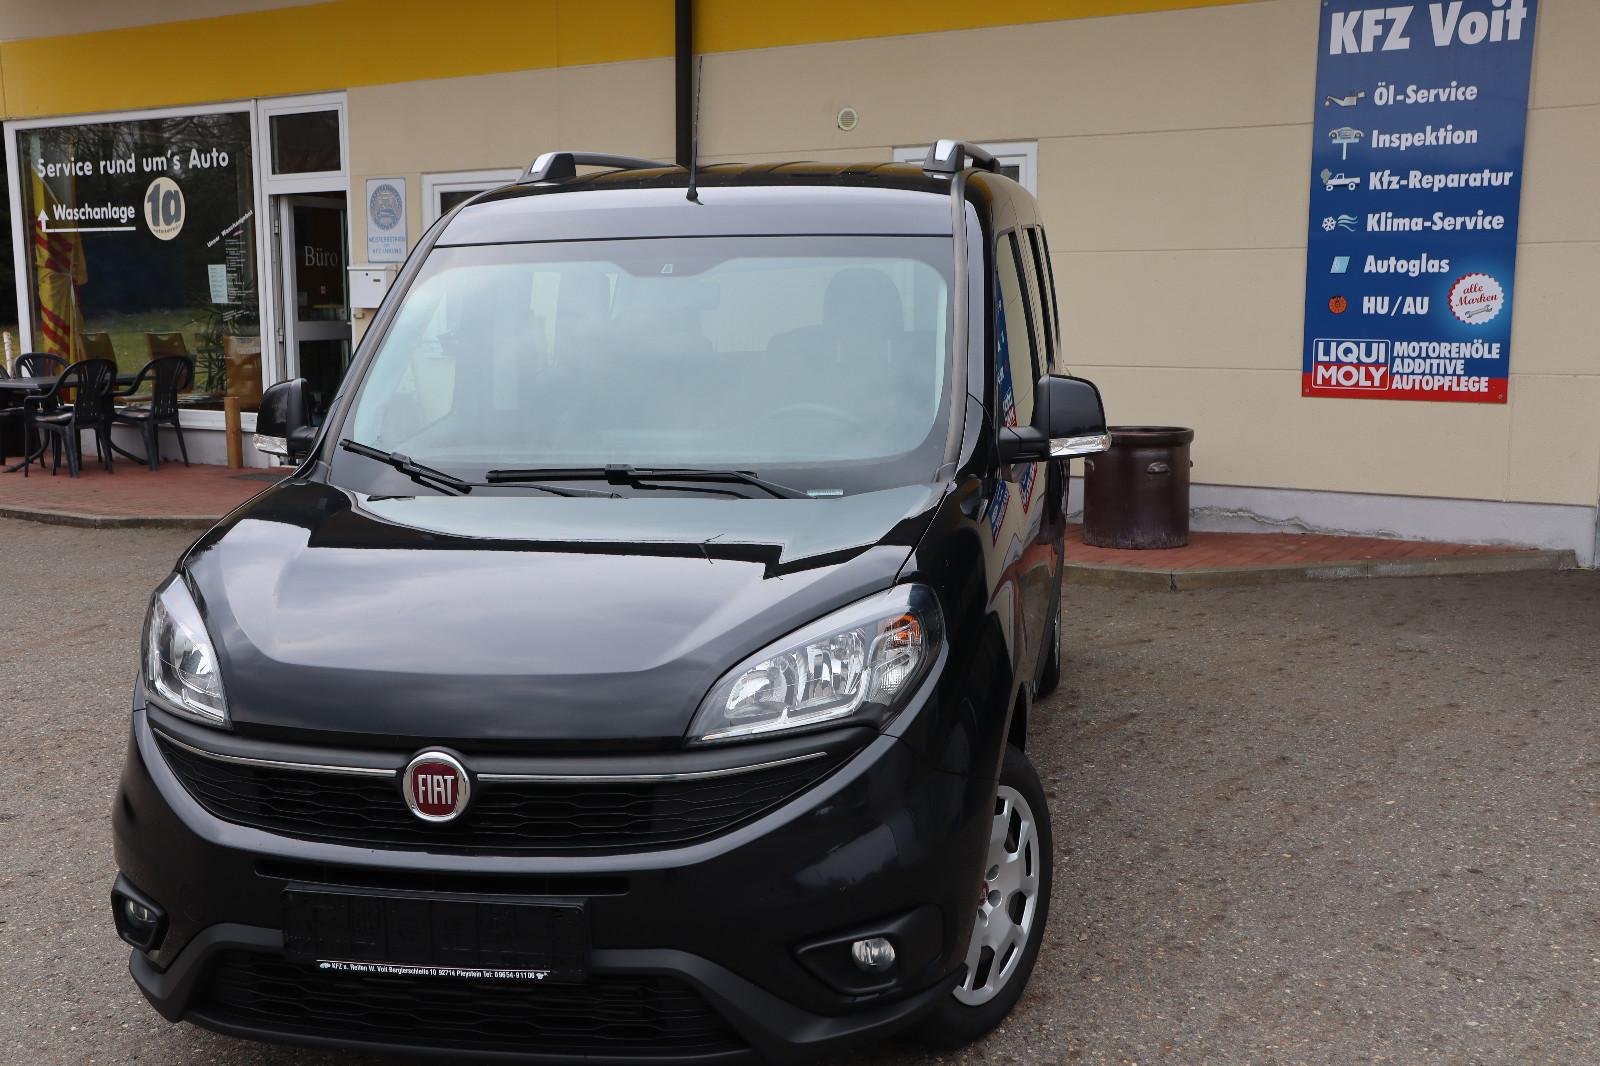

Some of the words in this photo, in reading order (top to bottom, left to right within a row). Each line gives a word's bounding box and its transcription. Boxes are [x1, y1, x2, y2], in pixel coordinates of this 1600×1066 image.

[1329, 6, 1414, 55] KFZ
[1429, 0, 1527, 47] Voit
[1374, 81, 1478, 106] Öl-Service
[1371, 124, 1478, 151] Inspektion
[37, 157, 93, 177] Service
[100, 153, 136, 174] rund
[143, 149, 180, 172] um's
[188, 147, 229, 169] Auto
[1368, 169, 1513, 192] Kfz-Reparatur
[53, 202, 136, 222] Waschanlage
[1366, 209, 1505, 232] Klima-Service
[304, 245, 338, 266] Büro
[1363, 253, 1450, 277] Autoglas
[1456, 293, 1499, 308] Marken
[1463, 284, 1484, 295] alle
[1317, 341, 1386, 364] LIQUI
[1393, 339, 1500, 359] MOTORENÖLE
[1316, 365, 1388, 387] MOLY
[1392, 359, 1465, 375] ADDITIVE
[1391, 375, 1489, 392] AUTOPFLEGE
[418, 774, 455, 805] FIAT
